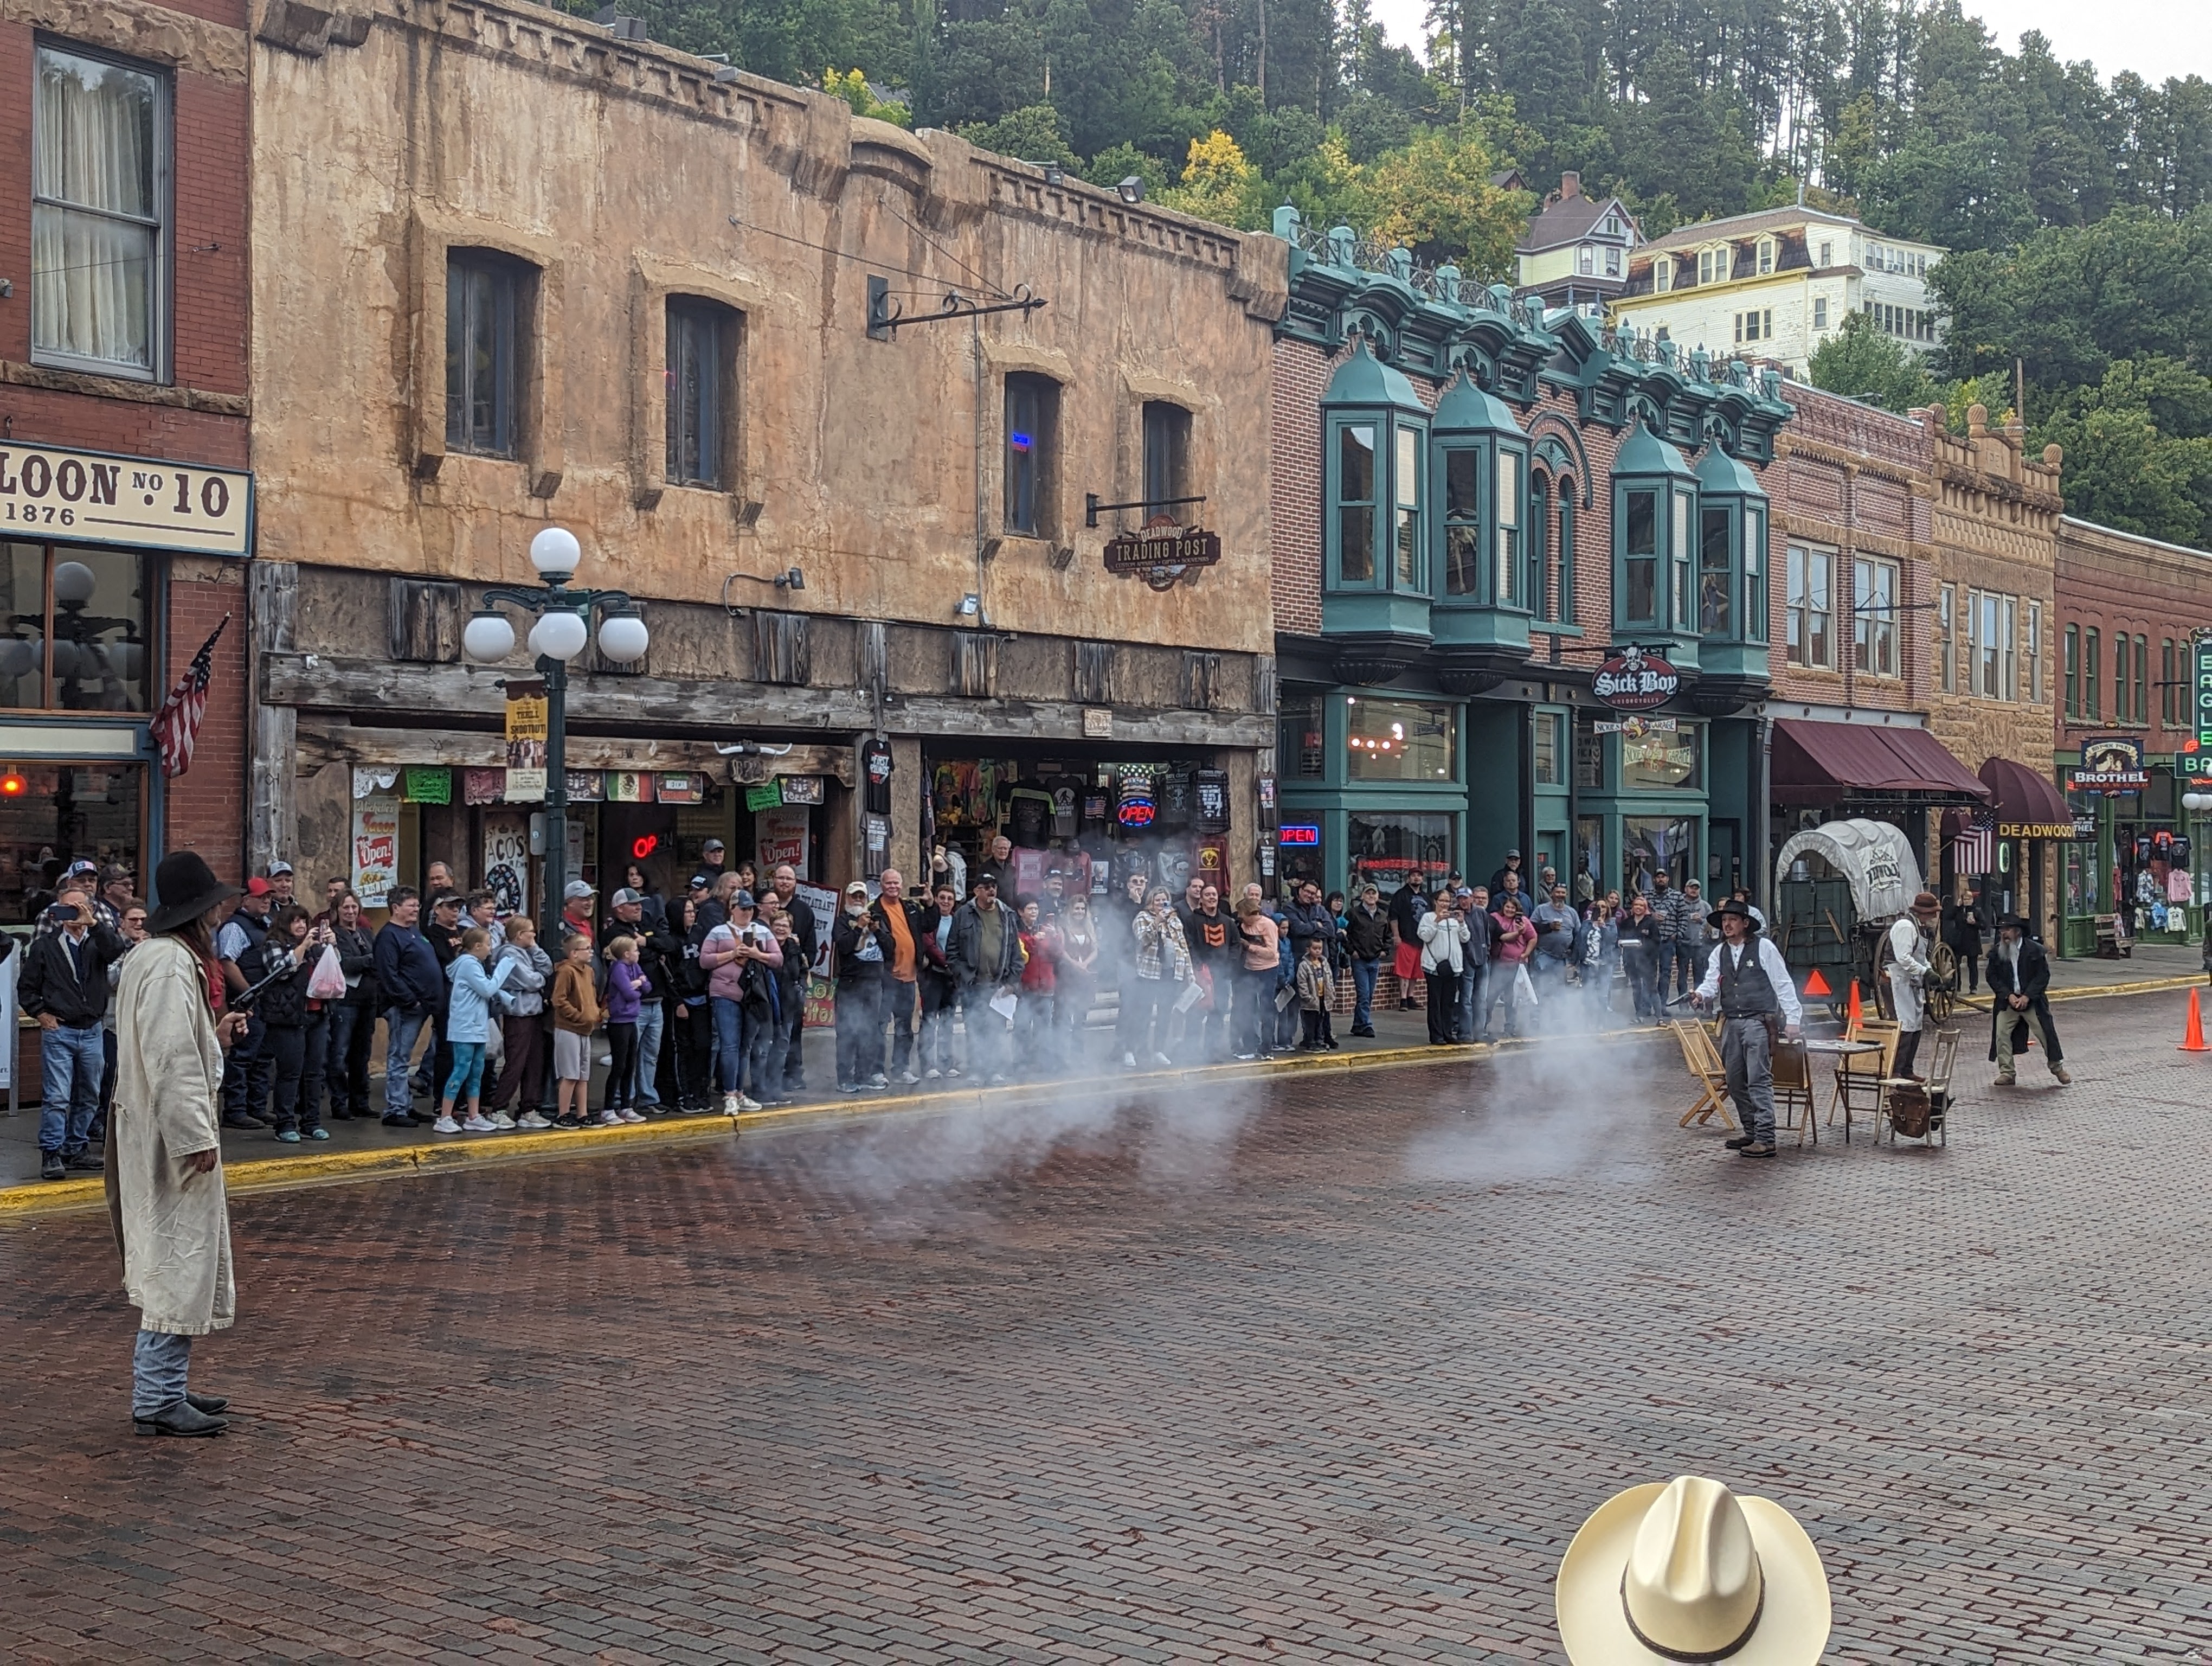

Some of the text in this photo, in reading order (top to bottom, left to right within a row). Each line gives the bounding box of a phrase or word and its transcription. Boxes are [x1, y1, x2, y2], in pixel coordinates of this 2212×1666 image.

[173, 473, 230, 517] 10
[5, 503, 75, 526] 1876
[1140, 526, 1183, 542] DEADWOOD
[1117, 539, 1207, 561] TRADING POST
[1594, 671, 1677, 696] Sick Boy
[2074, 772, 2149, 783] BROTHEL
[788, 792, 813, 801] BEER
[1119, 806, 1155, 821] OPEN
[362, 841, 391, 868] Open!
[767, 842, 800, 863] Open!
